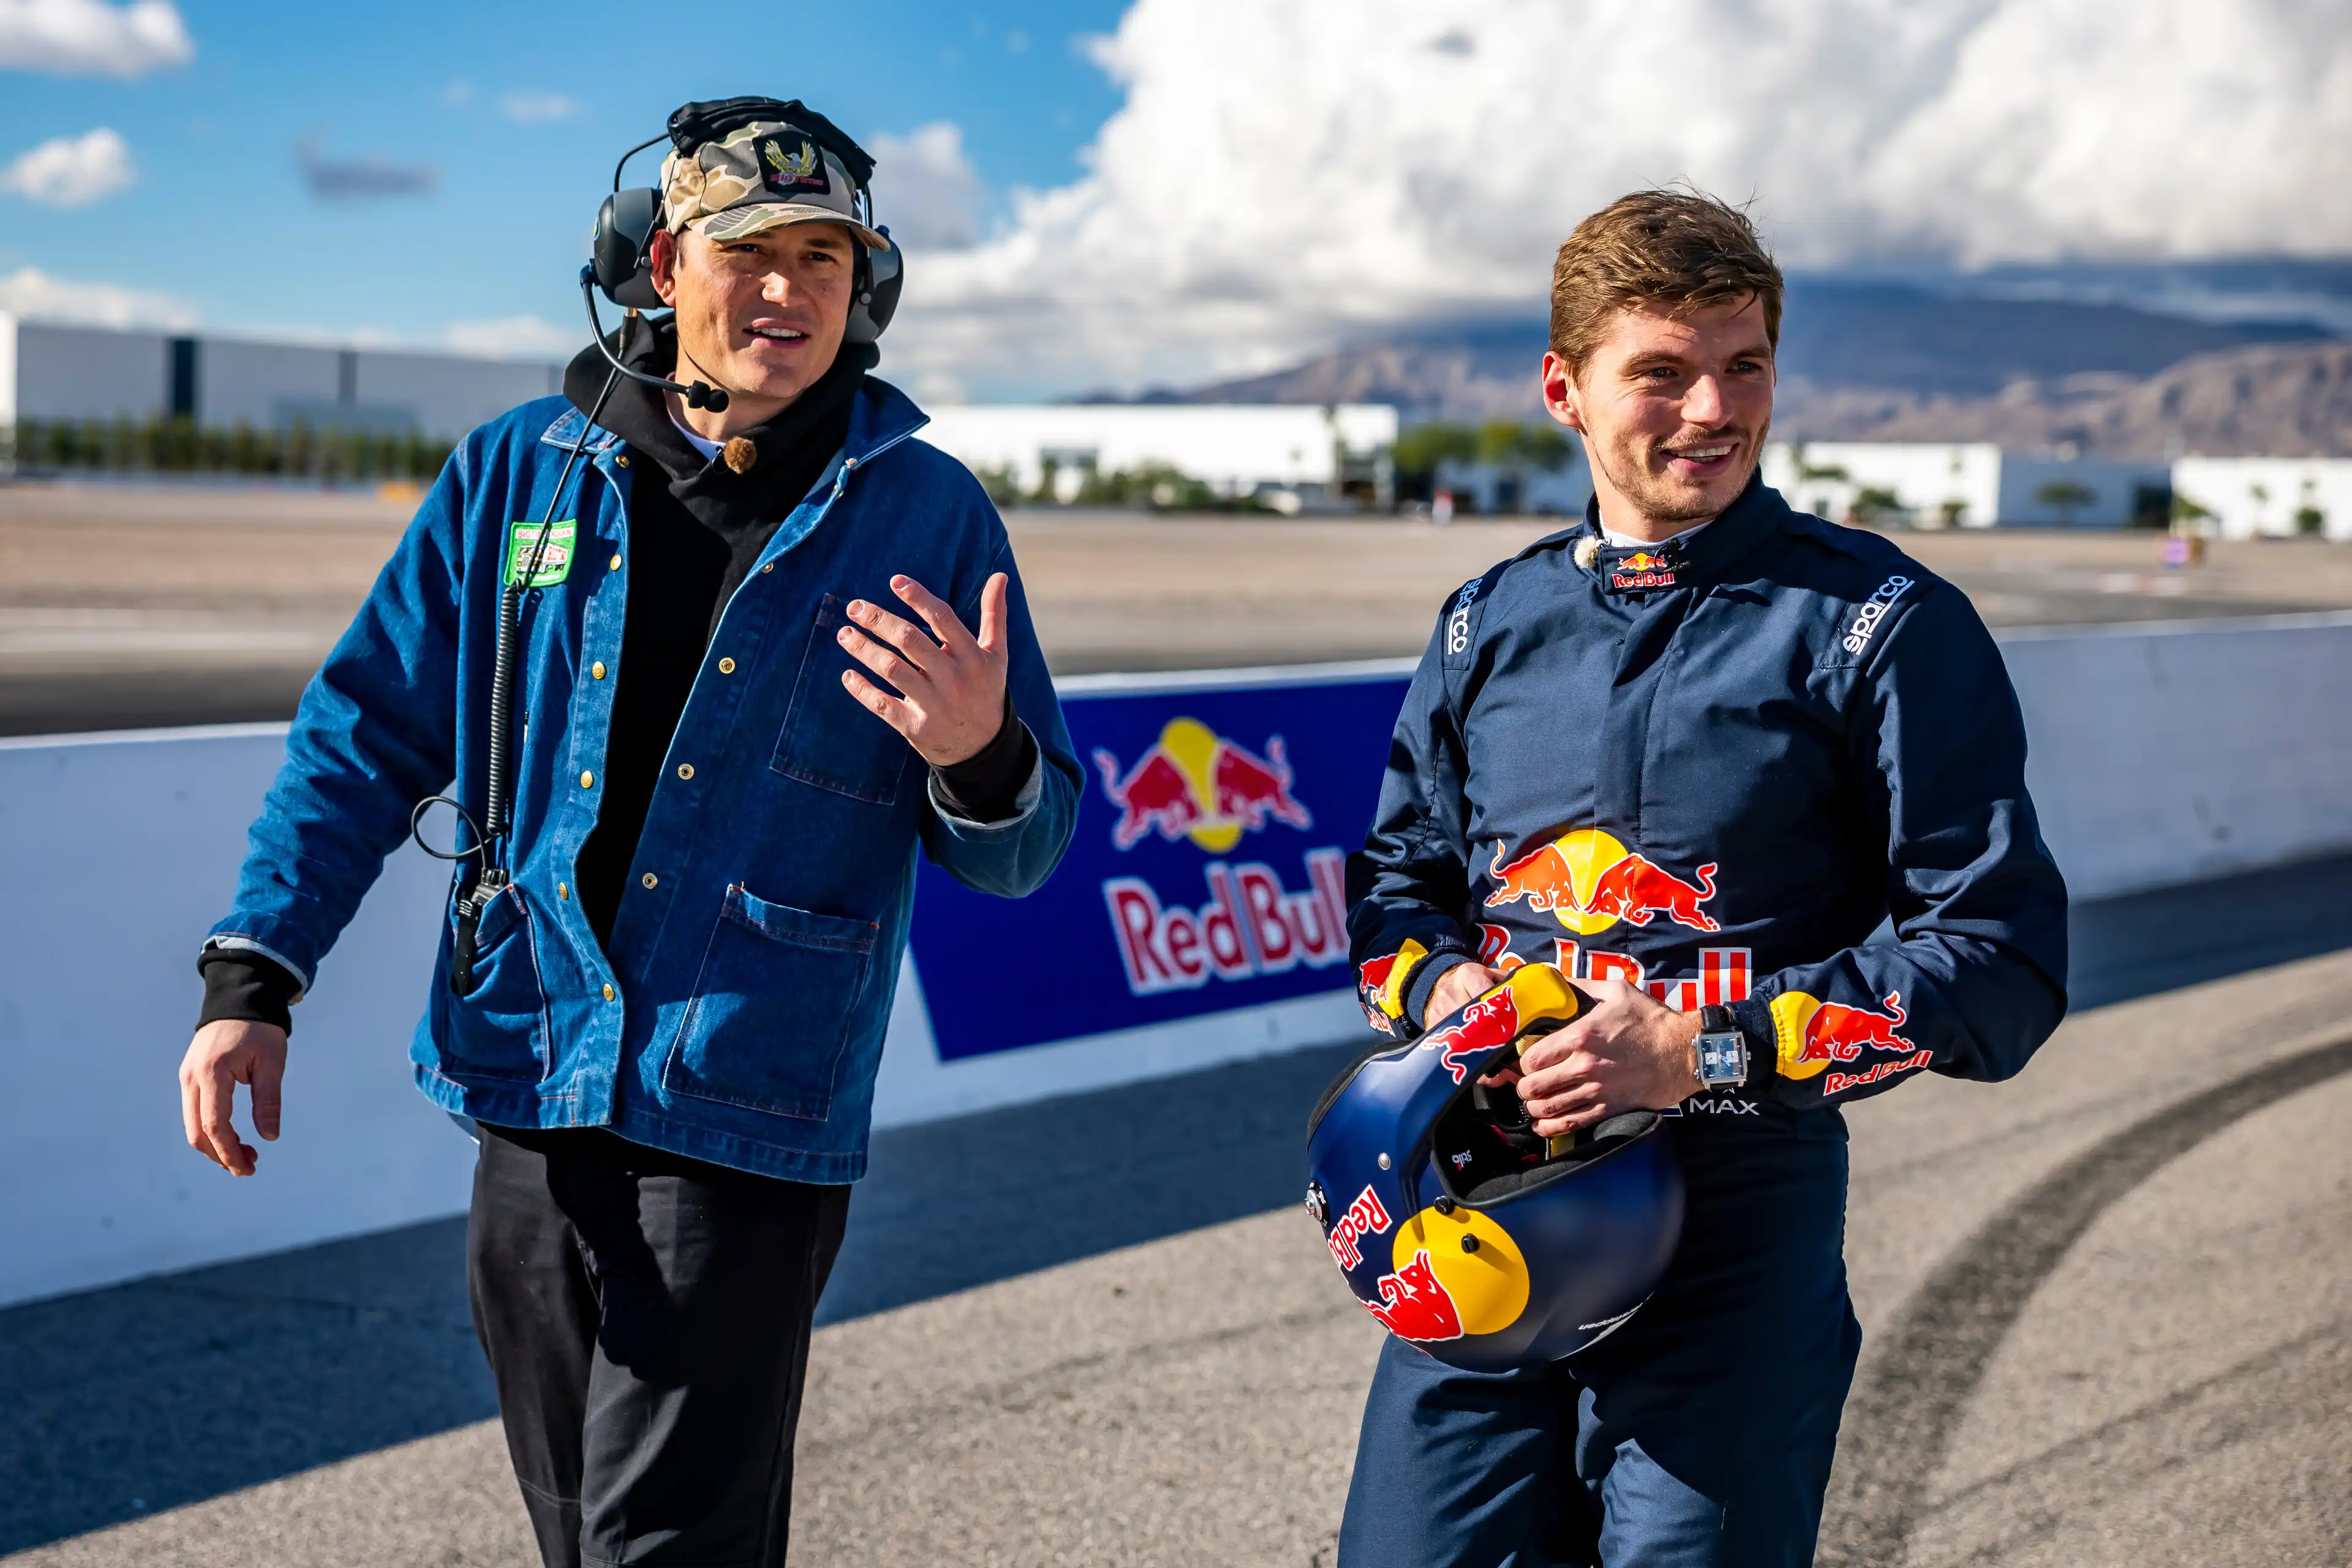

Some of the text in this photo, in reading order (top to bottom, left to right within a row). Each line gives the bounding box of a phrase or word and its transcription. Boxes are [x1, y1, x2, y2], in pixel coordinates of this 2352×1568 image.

[1451, 578, 1483, 654] sparco
[1611, 572, 1675, 588] Red Bull
[1842, 575, 1910, 654] sparco
[1104, 862, 1254, 996] Red
[1689, 1098, 1760, 1115] MAX
[1823, 1050, 1934, 1096] Red Bull
[1337, 1183, 1392, 1265] Red
